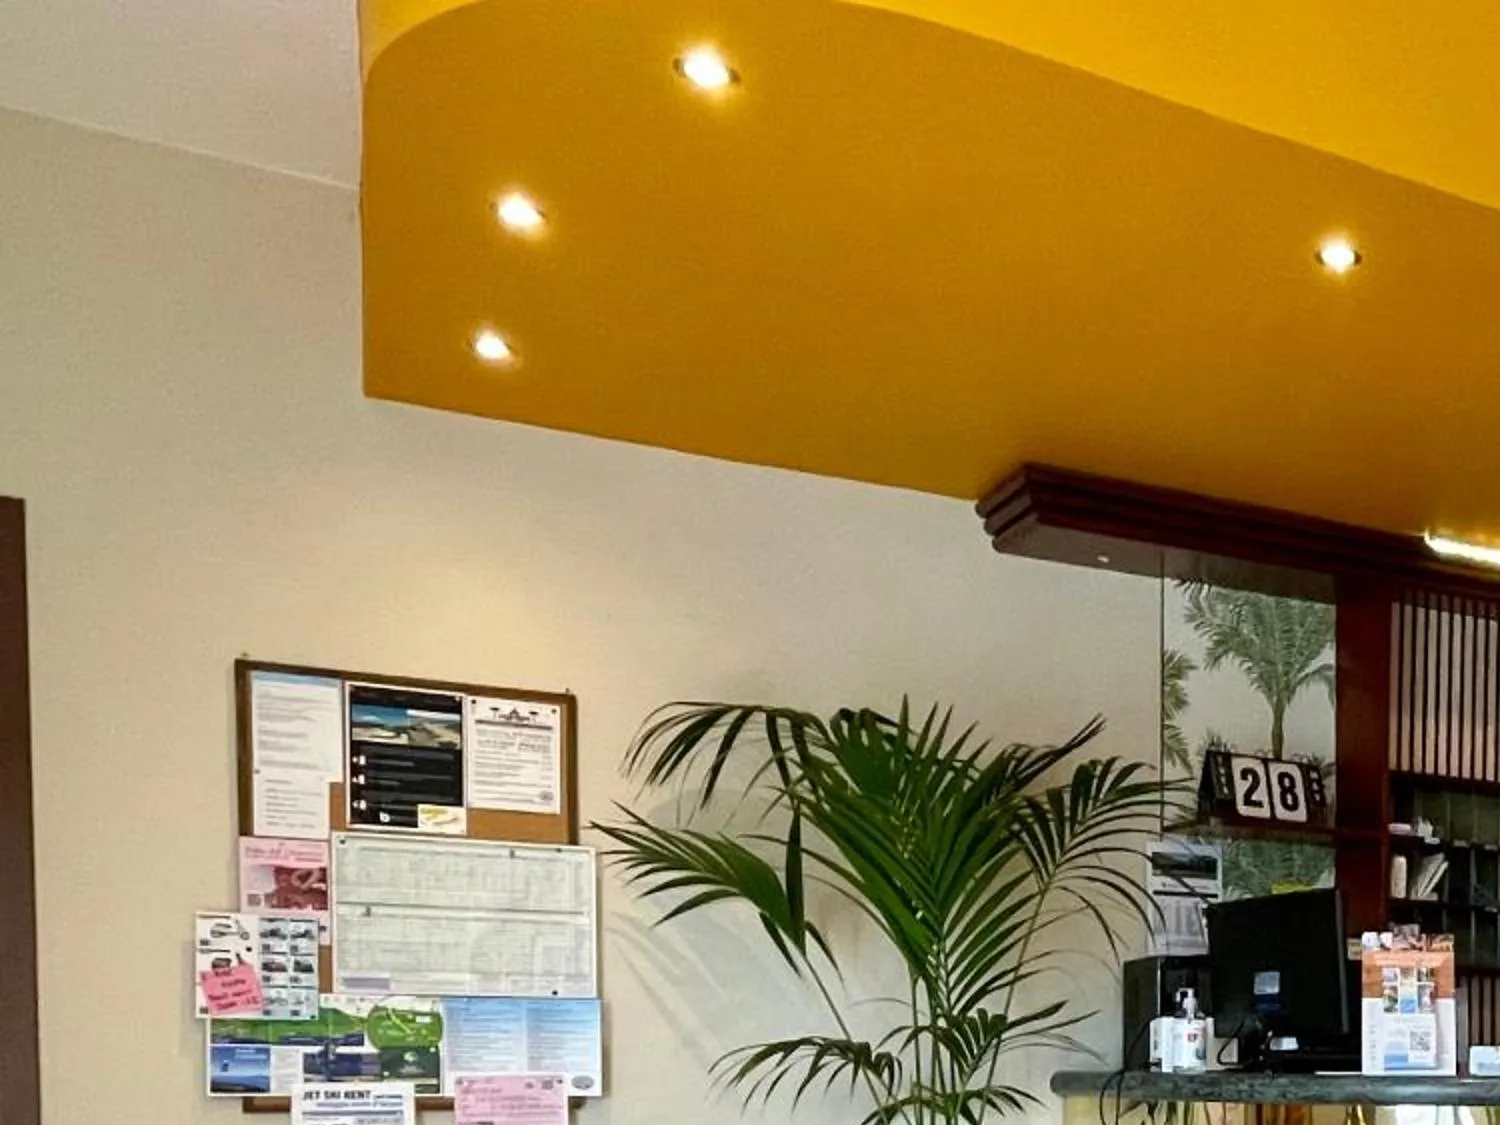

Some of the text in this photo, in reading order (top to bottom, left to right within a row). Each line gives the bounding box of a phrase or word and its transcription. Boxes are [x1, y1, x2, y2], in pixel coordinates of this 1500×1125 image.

[1240, 767, 1300, 812] 28
[303, 1091, 321, 1101] JET
[323, 1090, 342, 1100] SKI
[343, 1089, 372, 1099] RENT
